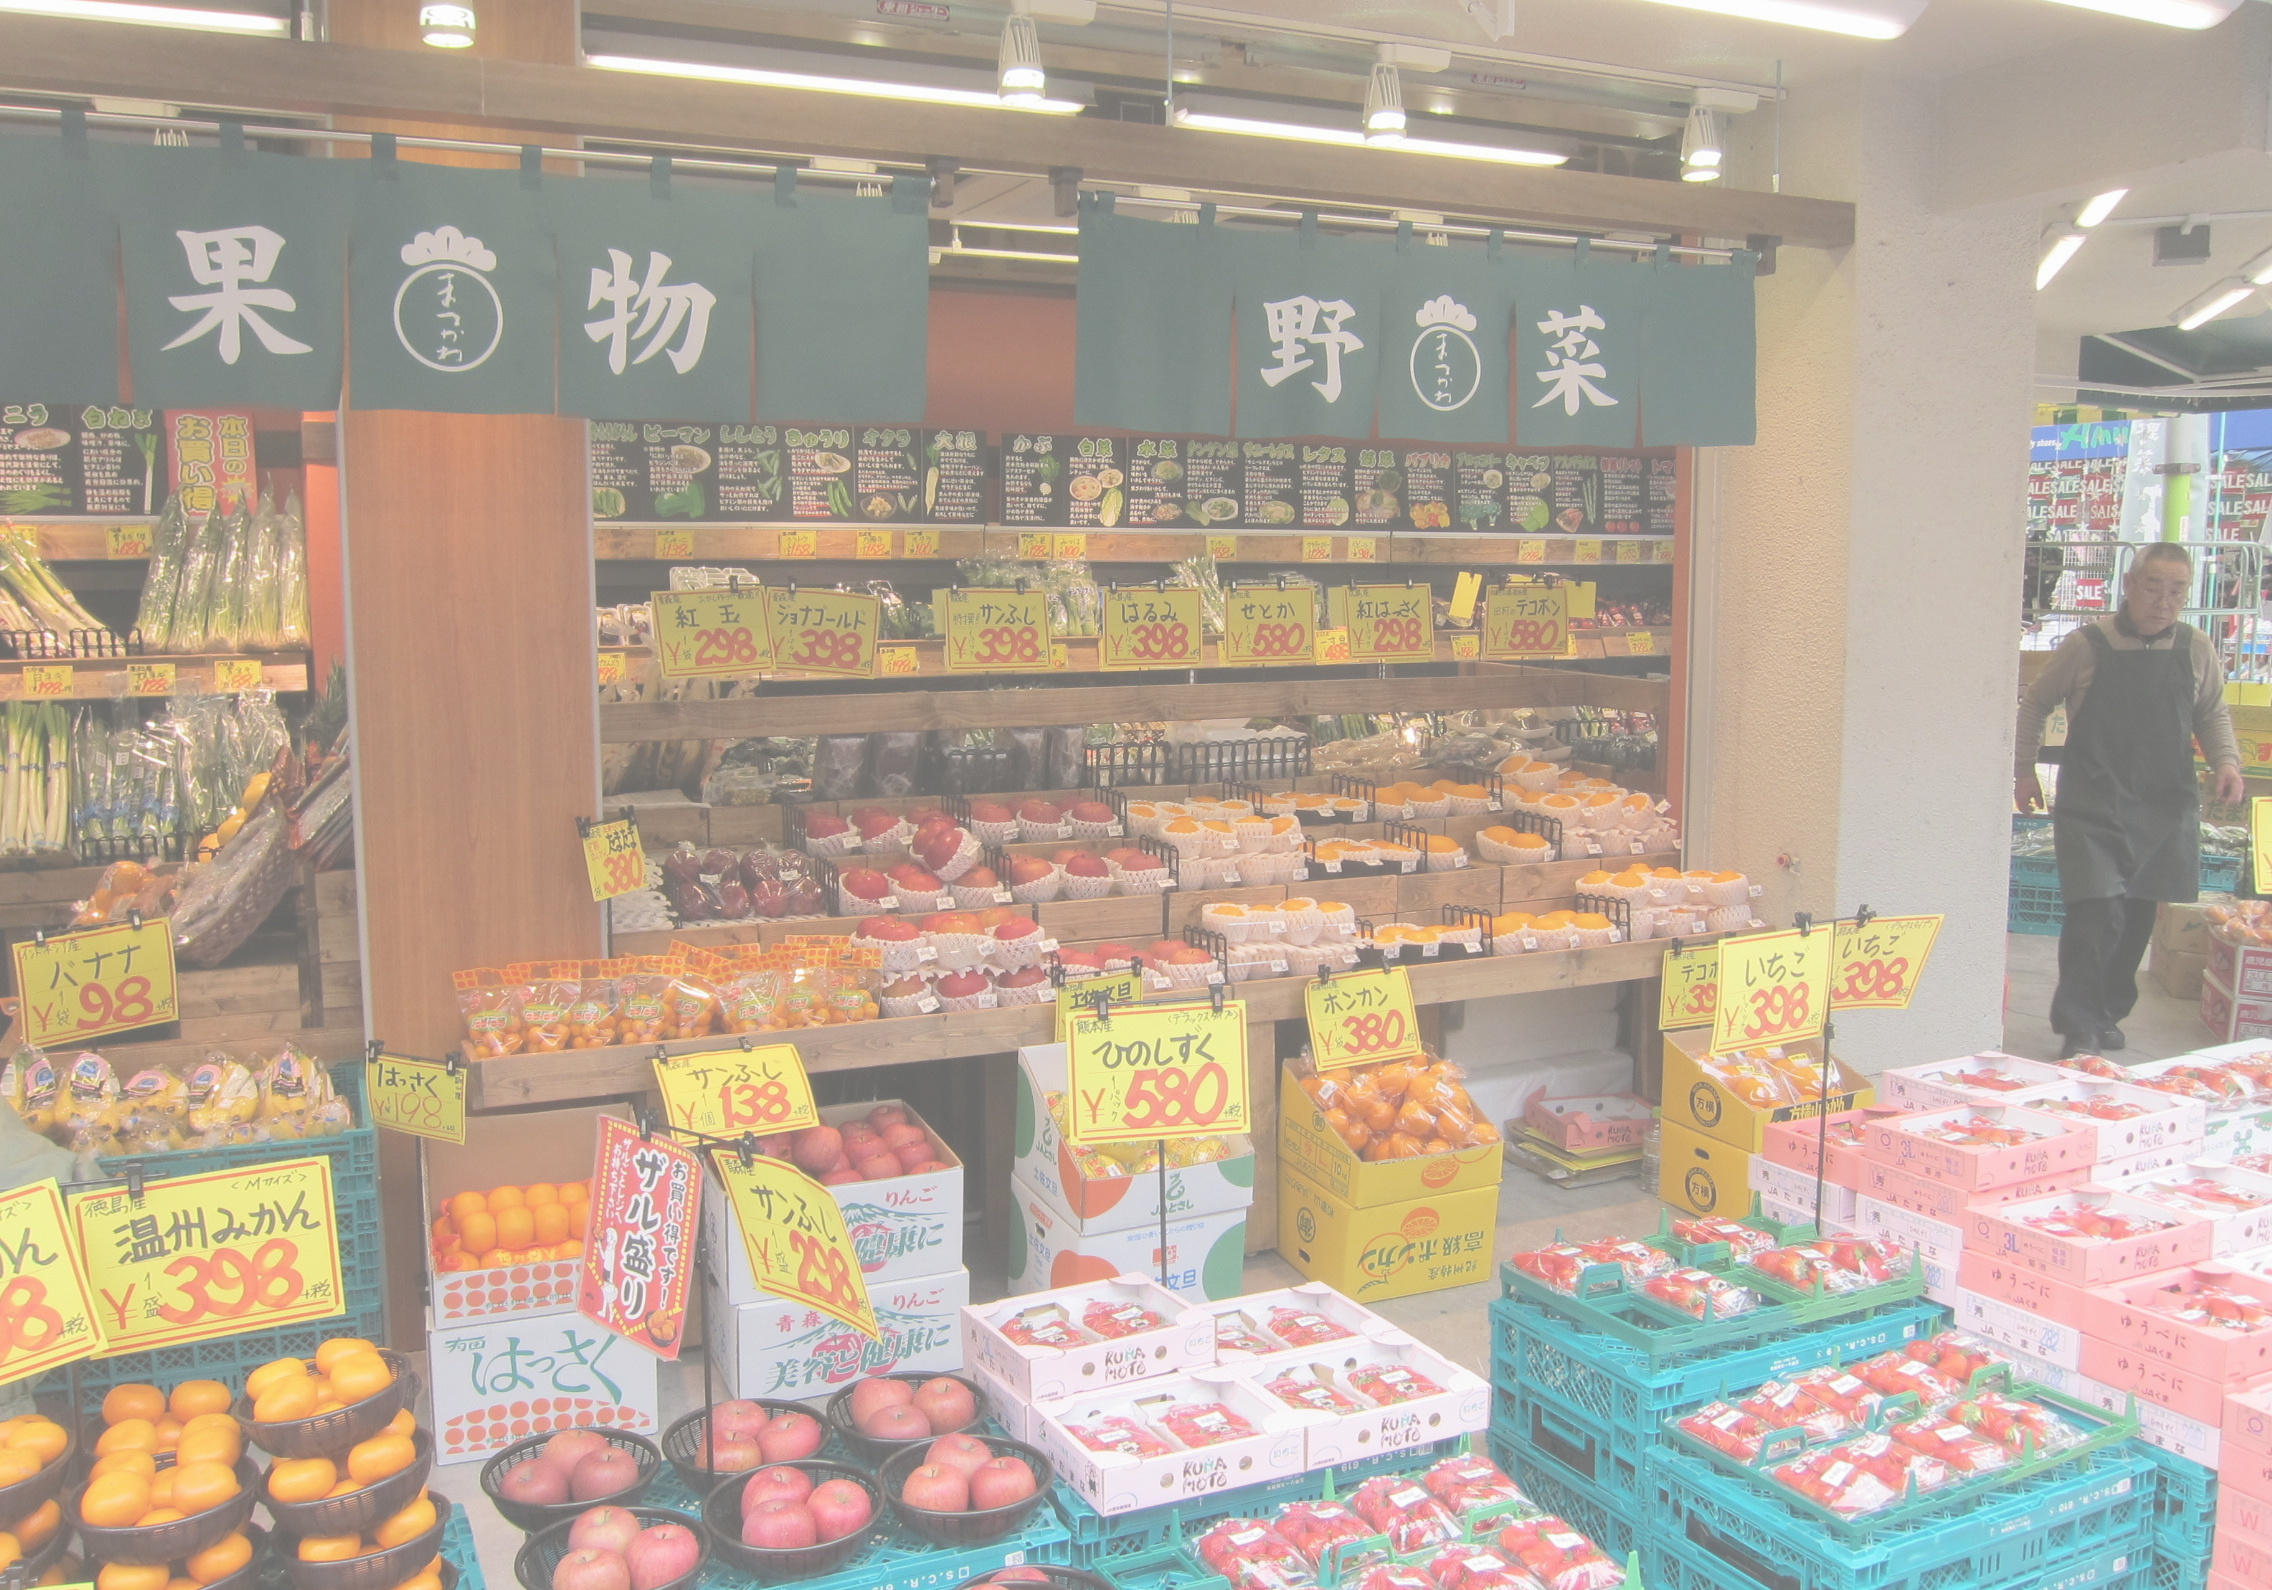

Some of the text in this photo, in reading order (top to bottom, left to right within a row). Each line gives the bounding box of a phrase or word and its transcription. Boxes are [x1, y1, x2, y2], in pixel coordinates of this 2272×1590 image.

[160, 225, 717, 375] 果 物
[434, 271, 464, 363] まつかわ
[1260, 294, 1619, 416] 野 菜
[1434, 332, 1453, 404] まつかわ
[3, 403, 49, 426] ニラ
[81, 405, 152, 430] 白ねぎ
[217, 416, 248, 474] 本日の
[643, 423, 711, 444] ピーマン
[719, 424, 777, 445] ししとう
[785, 428, 849, 448] きゅうり
[862, 428, 911, 448] オクラ
[933, 429, 977, 451] 大根
[1013, 434, 1052, 454] かぶ
[1077, 437, 1112, 457] 白菜
[1137, 438, 1178, 458] 水菜
[2060, 423, 2129, 450] Amu
[176, 415, 218, 513] お買い得
[1302, 446, 1347, 463] レタス
[1505, 452, 1550, 471] キャベツ
[2050, 480, 2079, 493] SALE
[2080, 479, 2111, 493] SALE
[2048, 505, 2077, 518] SALE
[2076, 584, 2101, 600] SALE
[675, 604, 741, 628] 紅玉
[979, 603, 1038, 626] サンふじ
[1121, 601, 1178, 623] はるみ
[1241, 603, 1295, 620] せとか
[1356, 599, 1421, 620] 紅はっさく
[693, 627, 758, 666] 298
[792, 628, 863, 669] 398
[974, 626, 1040, 664] 398
[1131, 623, 1189, 660] 398
[1251, 623, 1305, 657] 580
[1373, 618, 1423, 652] 298
[1507, 619, 1559, 651] 580
[603, 849, 643, 895] 380
[1842, 931, 1907, 959] いちご
[50, 944, 142, 990] バナナ
[1746, 944, 1810, 987] いちご
[1832, 958, 1908, 999] 398
[76, 975, 155, 1031] 98
[1323, 990, 1389, 1015] ポンカン
[1744, 982, 1810, 1039] 398
[1342, 1009, 1405, 1054] 380
[1092, 1028, 1215, 1069] ひのしずく
[377, 1063, 438, 1097] はっさく
[688, 1060, 784, 1090] サンふじ
[394, 1092, 442, 1129] 198
[718, 1081, 792, 1128] 138
[1121, 1062, 1229, 1128] 580
[885, 1185, 938, 1208] りんご
[1033, 1167, 1058, 1197] 土佐文旦
[113, 1190, 321, 1265] 温州みかん
[750, 1185, 838, 1244] サンふじ
[620, 1148, 670, 1320] ザル盛り
[660, 1159, 688, 1310] お買い得です!
[1357, 1230, 1485, 1272] 高級ポンカン
[159, 1238, 304, 1325] 398
[788, 1230, 860, 1315] 298
[1427, 1259, 1479, 1282] 紀州特産
[1992, 1268, 2051, 1299] ゆうべに
[776, 1288, 945, 1333] 青森 りんご
[445, 1336, 487, 1353] 有田
[2120, 1315, 2188, 1350] ゆうべに
[471, 1329, 622, 1406] はっさく
[764, 1324, 951, 1395] 美容と健康に
[1104, 1345, 1146, 1365] KUMA
[1105, 1361, 1146, 1382] MOTO
[2117, 1357, 2185, 1393] ゆうべに
[1380, 1427, 1421, 1449] MOTO
[1381, 1413, 1421, 1432] KUMA
[1182, 1472, 1228, 1494] MOTO
[1183, 1456, 1228, 1478] KUMA
